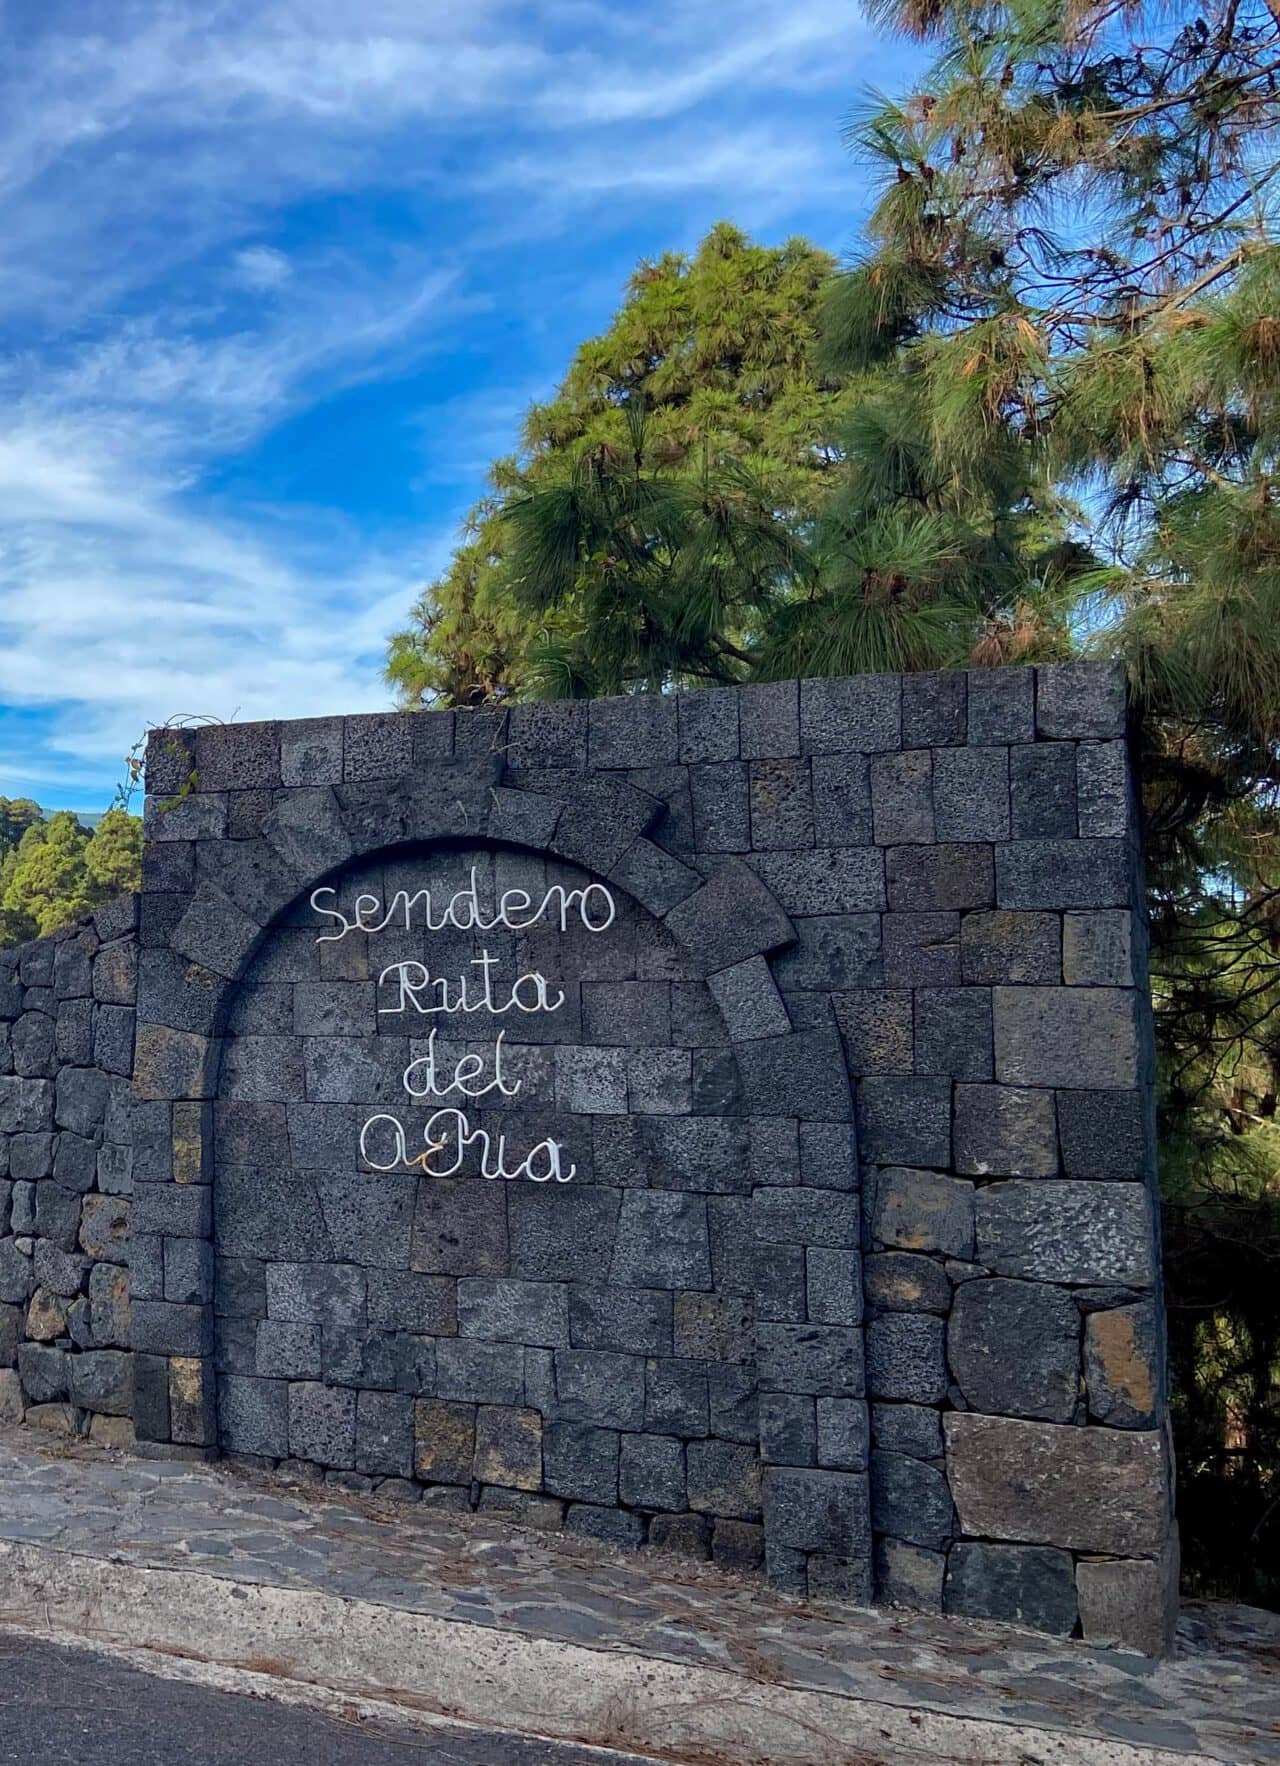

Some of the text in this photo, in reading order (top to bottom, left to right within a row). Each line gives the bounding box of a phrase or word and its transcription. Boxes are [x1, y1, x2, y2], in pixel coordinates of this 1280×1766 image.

[310, 866, 615, 942] Sendero
[378, 949, 564, 1013] Ruta
[403, 1028, 521, 1096] del
